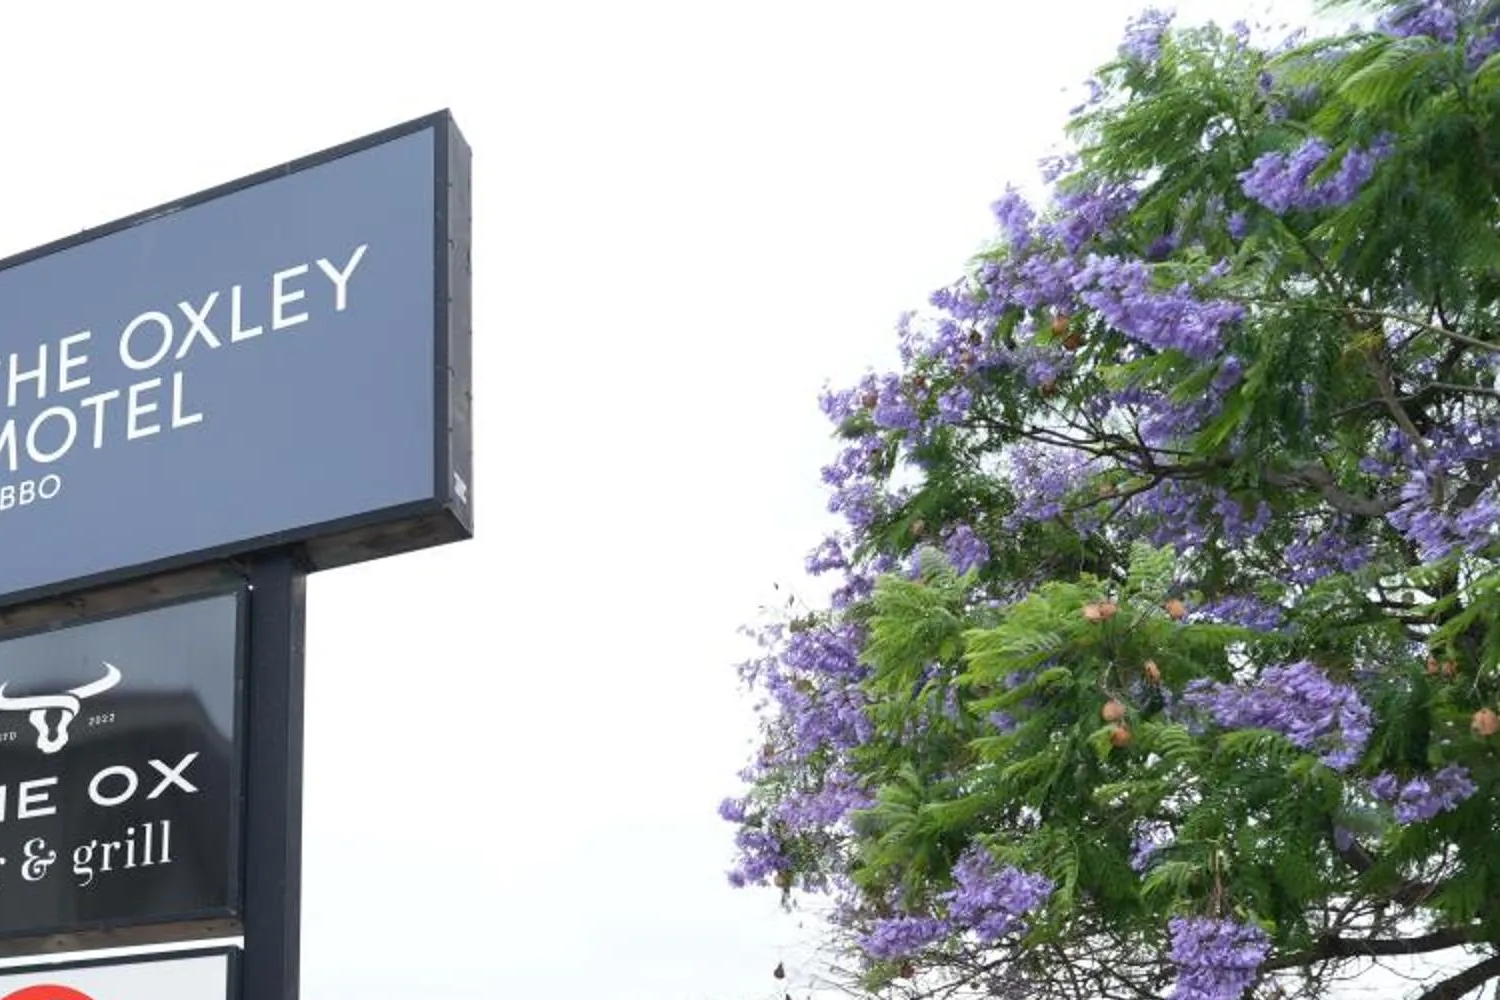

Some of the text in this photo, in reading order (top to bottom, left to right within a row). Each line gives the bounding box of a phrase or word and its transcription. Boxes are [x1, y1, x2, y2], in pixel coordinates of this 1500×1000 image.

[118, 245, 368, 371] OXLEY
[88, 752, 199, 806] OX
[21, 837, 57, 881] &
[72, 820, 172, 886] grill
